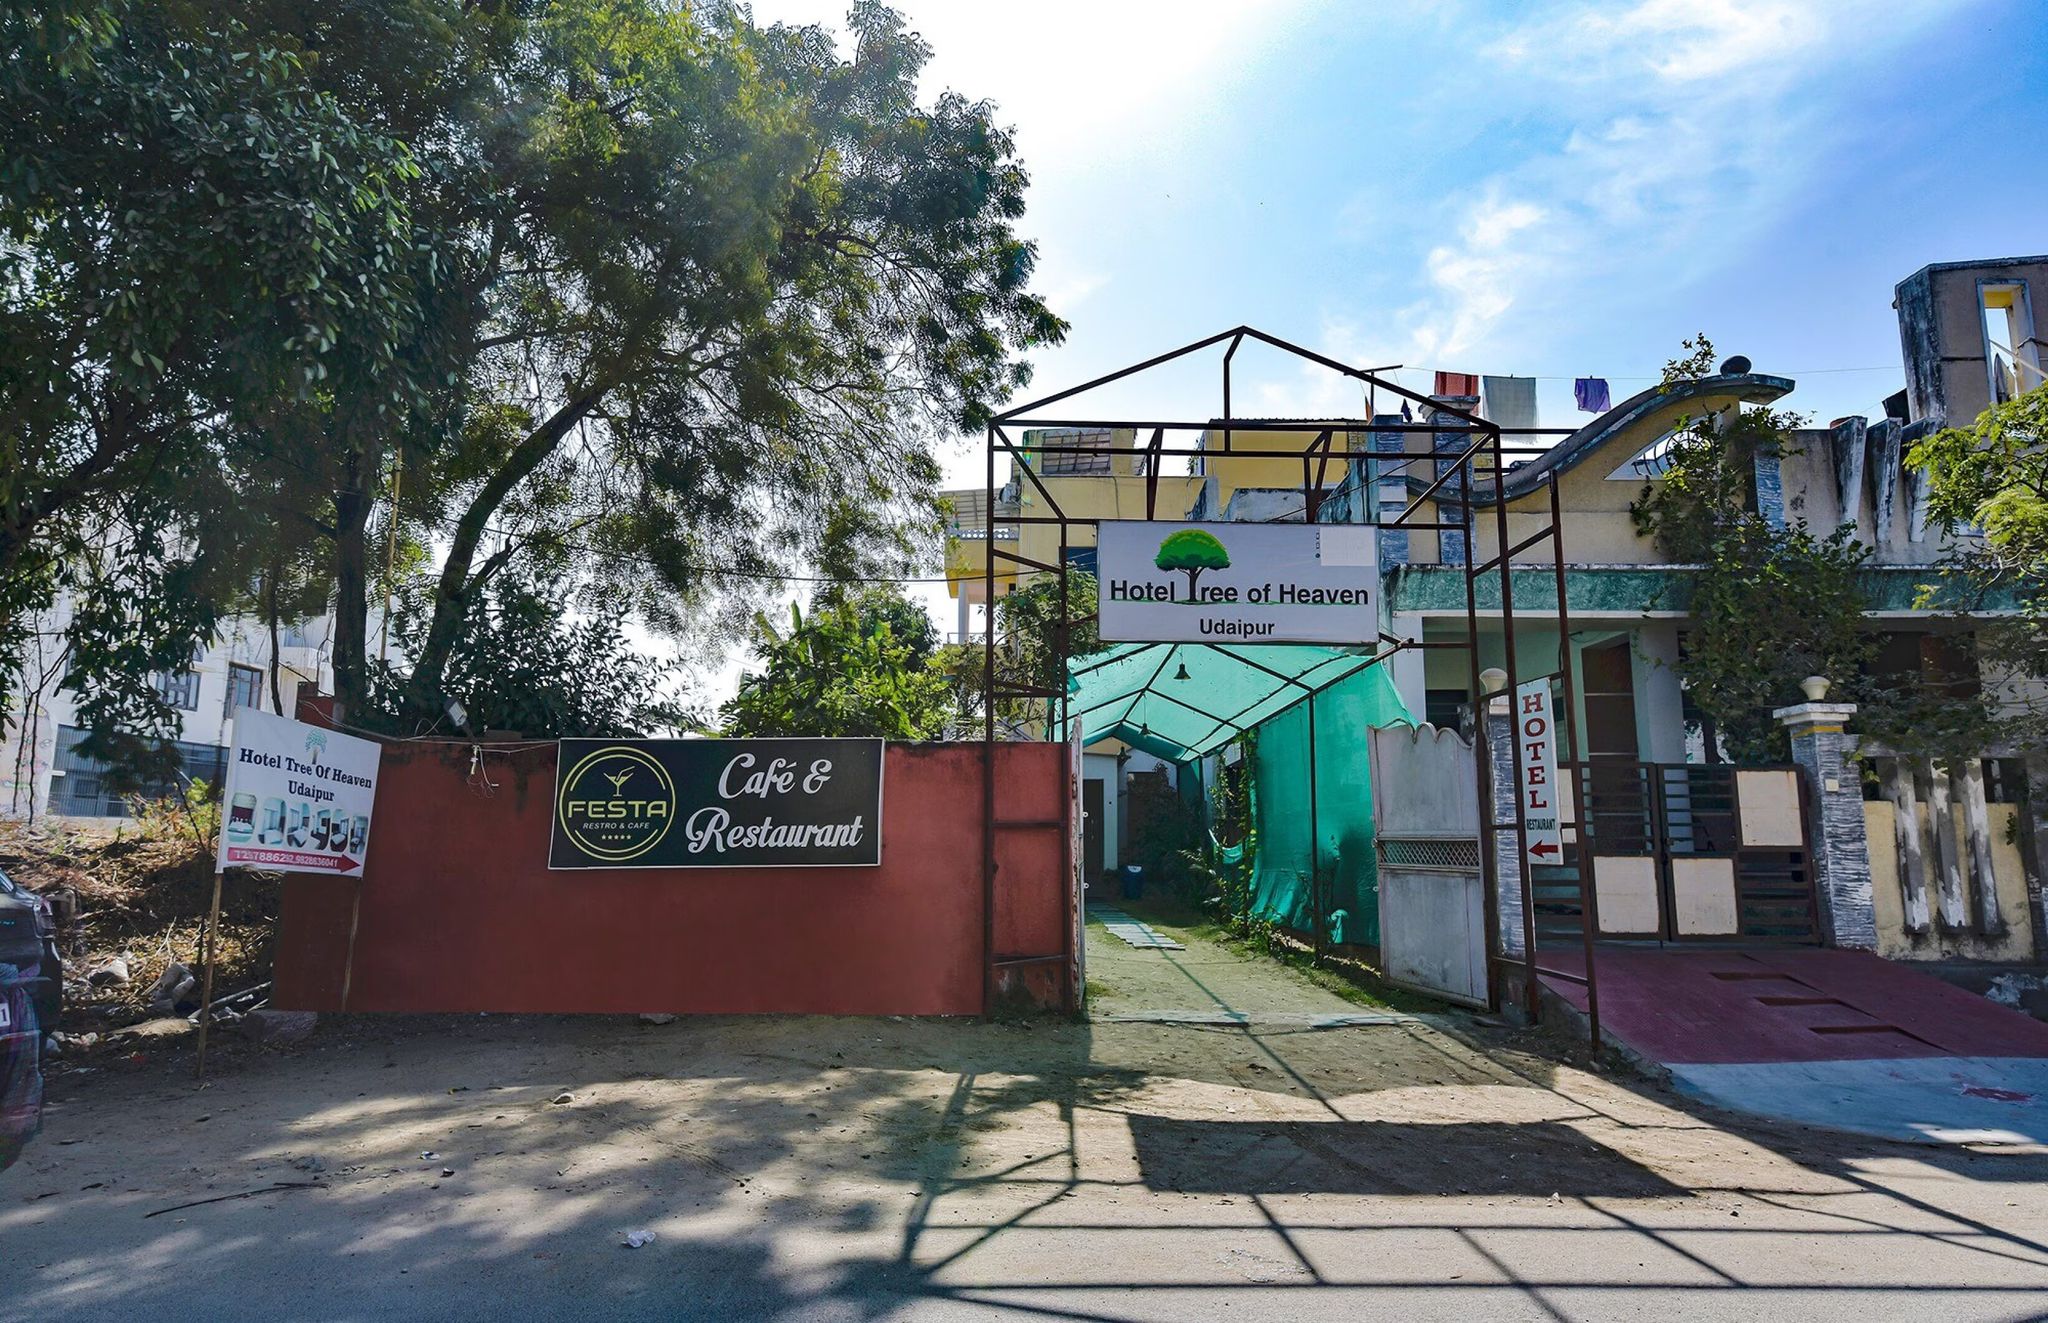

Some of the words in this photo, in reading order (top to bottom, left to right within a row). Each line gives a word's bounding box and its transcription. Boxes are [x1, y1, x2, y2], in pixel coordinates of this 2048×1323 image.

[1110, 580, 1175, 602] Hotel
[1247, 584, 1272, 603] of
[1279, 583, 1369, 605] Heaven
[1199, 618, 1275, 638] Udaipur
[1522, 692, 1547, 809] HOTEL
[239, 748, 282, 769] Hotel
[285, 757, 312, 776] Tree
[315, 764, 331, 779] Of
[332, 768, 372, 789] Heaven
[717, 753, 797, 799] Café
[803, 759, 833, 795] &
[288, 780, 335, 802] Udaipur
[568, 801, 667, 818] FESTA
[582, 822, 617, 830] RESTRO
[619, 822, 625, 830] &
[685, 807, 863, 854] Restaurant
[1526, 818, 1556, 831] RESTAURANT
